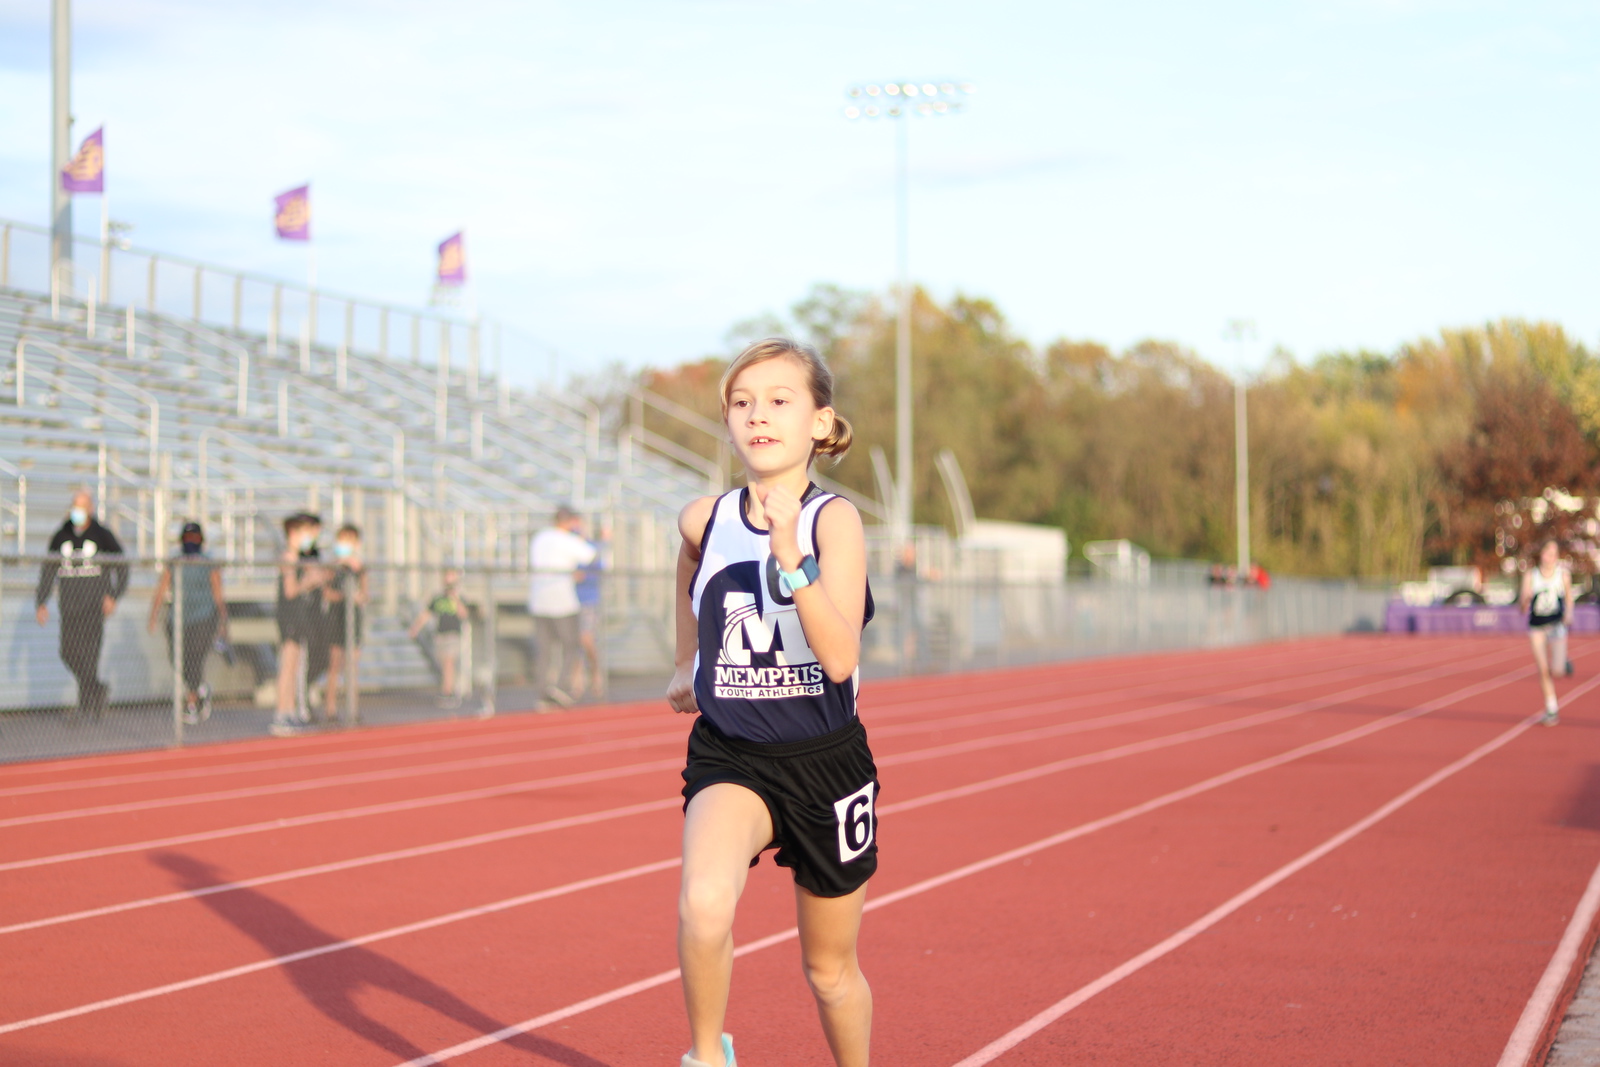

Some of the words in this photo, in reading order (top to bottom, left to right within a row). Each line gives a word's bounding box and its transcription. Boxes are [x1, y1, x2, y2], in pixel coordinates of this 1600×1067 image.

[714, 664, 823, 686] MEMPHIS
[719, 688, 753, 697] YOUTH
[758, 685, 822, 697] ATHLETICS
[844, 794, 870, 852] 6
